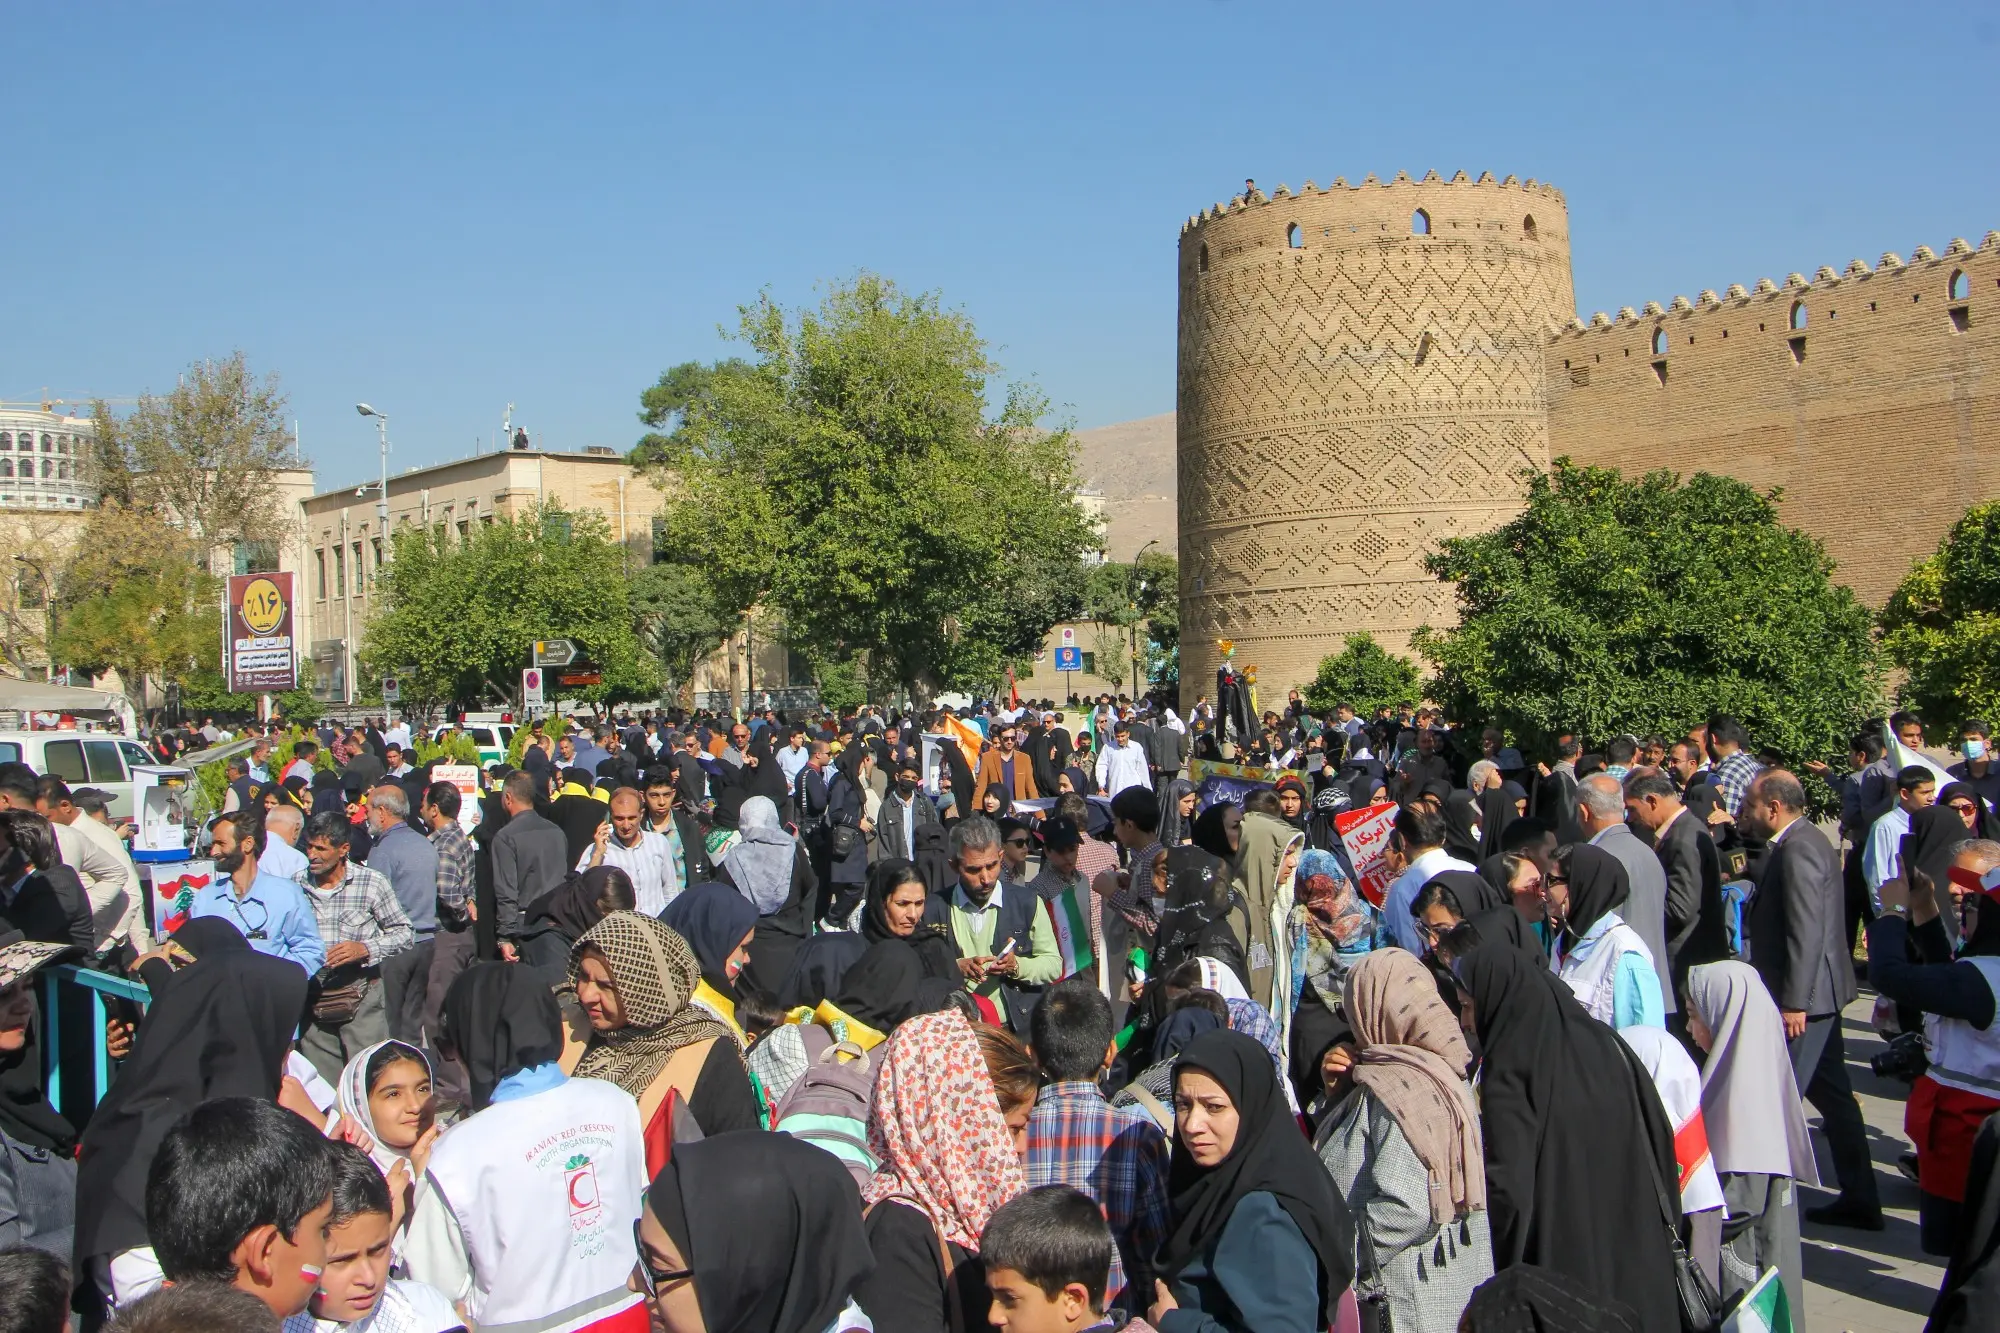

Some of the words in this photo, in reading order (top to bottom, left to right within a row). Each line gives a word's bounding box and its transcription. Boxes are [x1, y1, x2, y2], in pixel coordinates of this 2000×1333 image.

[264, 637, 278, 648] آبان
[436, 770, 455, 779] آمریکا
[462, 770, 475, 779] مرگ
[1356, 818, 1387, 845] آمریکا
[1347, 840, 1361, 854] را
[525, 1134, 558, 1163] IRANIAN
[560, 1127, 576, 1140] RED
[579, 1123, 616, 1134] CRESCENT
[535, 1146, 559, 1172] YOUTH
[559, 1136, 613, 1152] ORGANIZATION
